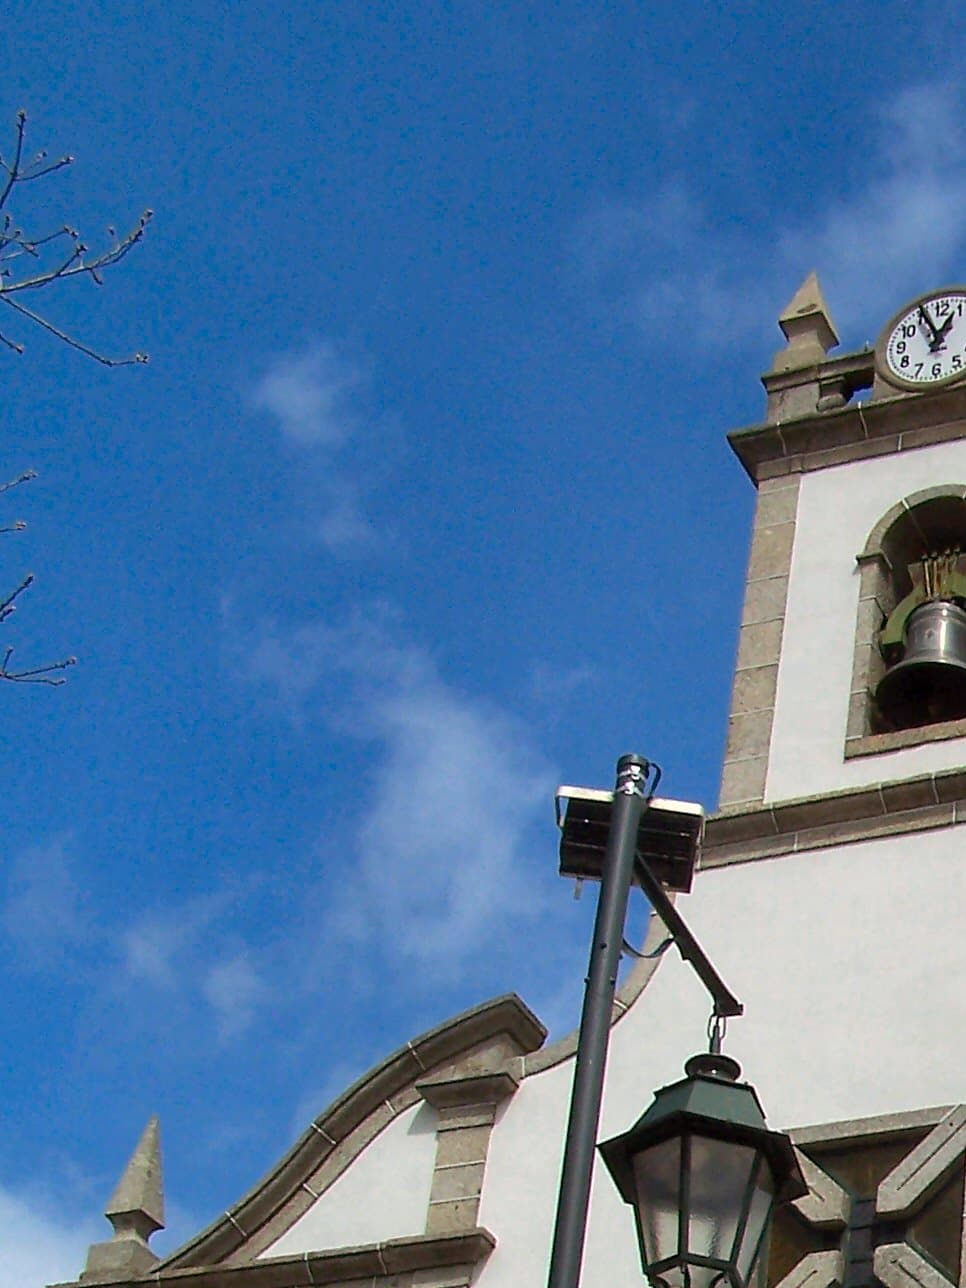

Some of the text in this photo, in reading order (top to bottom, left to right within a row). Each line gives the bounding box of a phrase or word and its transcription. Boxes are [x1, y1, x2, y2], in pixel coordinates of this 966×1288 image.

[936, 303, 949, 317] 12
[957, 303, 963, 317] 1
[902, 325, 916, 339] 10
[896, 342, 906, 354] 9
[901, 355, 909, 368] 8
[952, 355, 962, 368] 5
[914, 363, 924, 377] 7
[932, 363, 941, 377] 6
